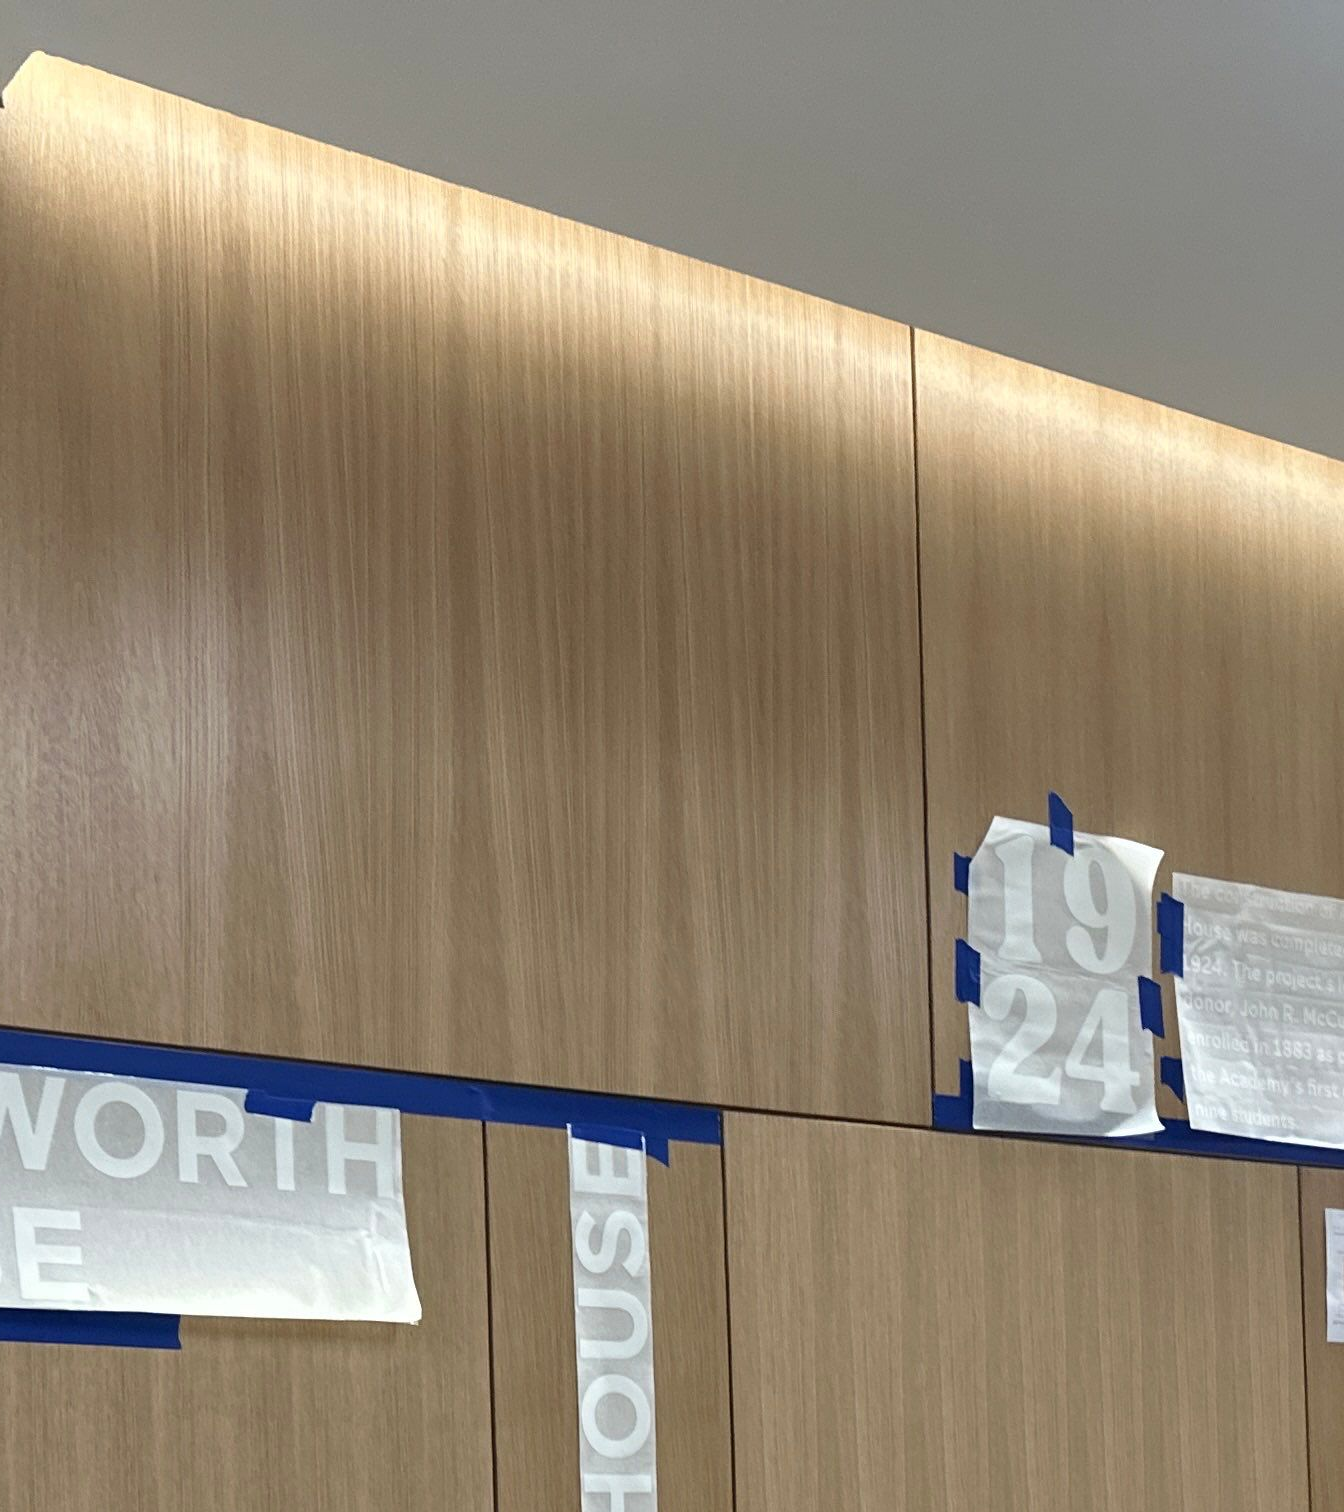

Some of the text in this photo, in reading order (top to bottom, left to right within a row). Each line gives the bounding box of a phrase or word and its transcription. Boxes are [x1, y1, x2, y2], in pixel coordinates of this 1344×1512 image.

[994, 834, 1137, 976] 19
[1236, 928, 1267, 946] was
[1183, 954, 1229, 978] 1924.
[1232, 959, 1262, 981] The
[1240, 1000, 1280, 1020] John
[1283, 1003, 1300, 1024] R.
[982, 972, 1142, 1115] 24
[1187, 1029, 1250, 1054] enrolled
[1253, 1037, 1271, 1057] in
[1316, 1047, 1336, 1064] as
[1191, 1062, 1217, 1083] the
[1307, 1078, 1340, 1098] first
[1193, 1101, 1228, 1122] nine
